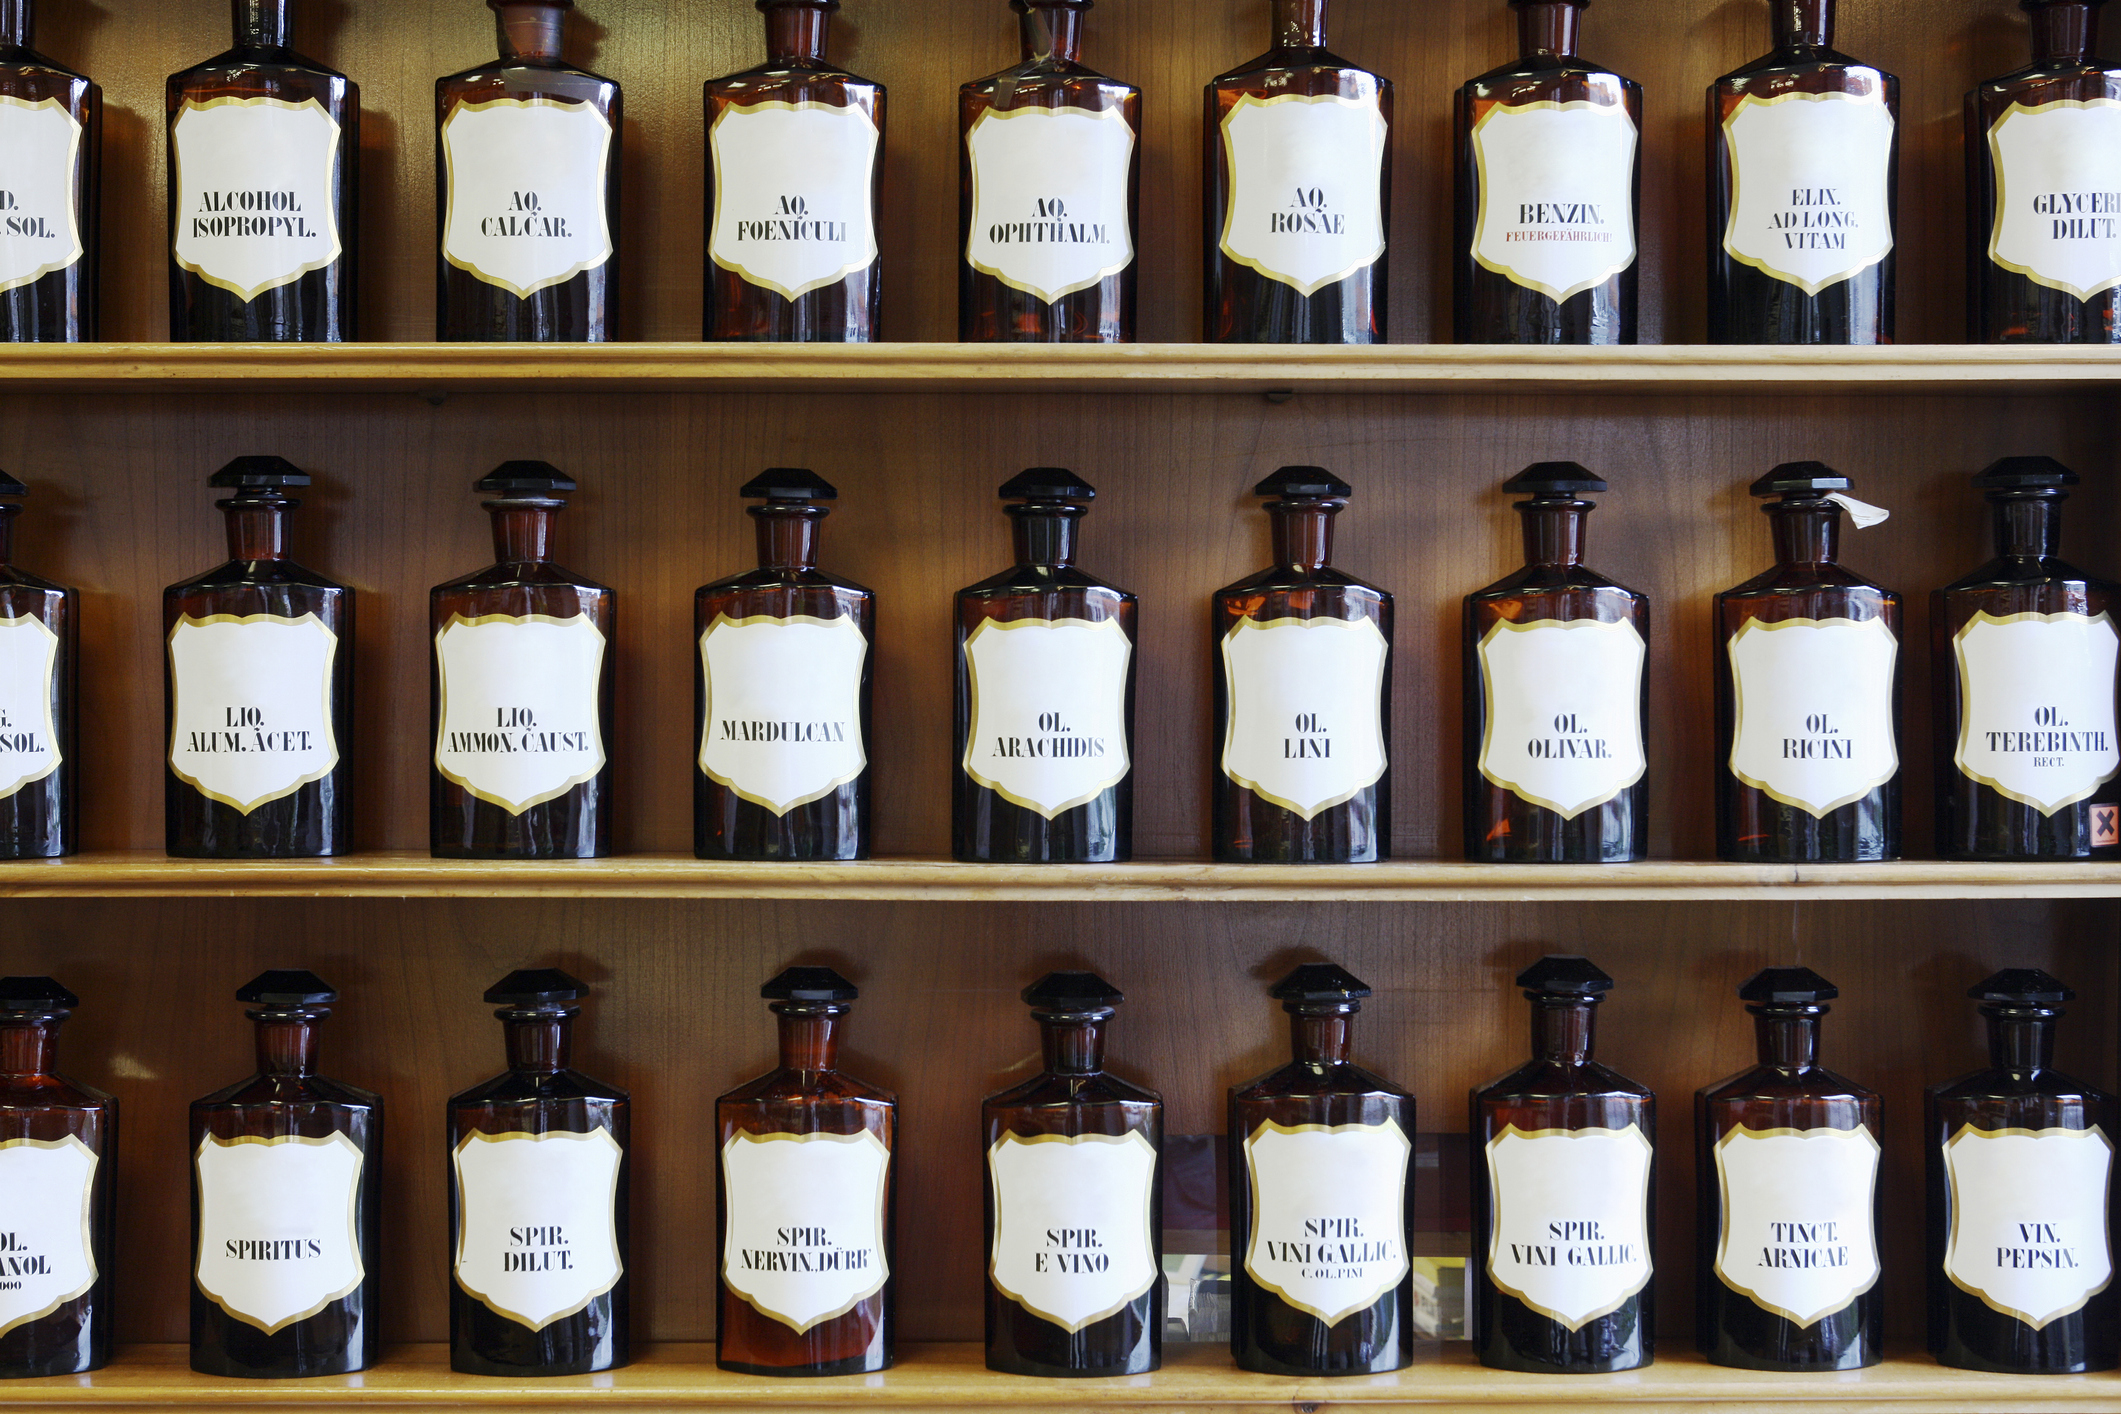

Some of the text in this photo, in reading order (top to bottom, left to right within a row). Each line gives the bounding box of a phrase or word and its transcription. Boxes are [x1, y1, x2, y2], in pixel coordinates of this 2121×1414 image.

[199, 190, 303, 212] ALCOHOL
[507, 190, 542, 217] AQ.
[774, 194, 809, 220] AQ.
[1288, 187, 1328, 213] AQ.
[1791, 188, 1841, 207] ELIX.
[1031, 197, 1068, 222] AQ.
[1519, 203, 1605, 225] BENZIN.
[1767, 210, 1859, 230] AD LONG.
[6, 215, 56, 239] SOL.
[192, 215, 317, 239] ISOPROPYL.
[481, 215, 572, 238] CALCAR.
[737, 220, 847, 242] FOENICULI
[989, 222, 1111, 245] OPHTHALM.
[1269, 212, 1345, 235] ROSAE
[2052, 218, 2117, 240] DILUT.
[1505, 228, 1613, 243] FEUERGEFÄHRLICH!
[1783, 232, 1847, 250] VITAM
[225, 706, 265, 731] LIQ.
[496, 707, 537, 732] LIQ.
[1039, 712, 1072, 733] OL.
[1295, 713, 1328, 734] OL.
[1554, 714, 1588, 735] OL.
[1806, 714, 1839, 734] OL.
[2034, 706, 2069, 727] OL.
[186, 730, 313, 753] ALUM. ACET.
[447, 731, 589, 753] AMMON. CAUST.
[719, 720, 846, 743] MARDULCAN
[1985, 731, 2109, 752] TEREBINTH.
[0, 732, 45, 754] SOL.
[992, 736, 1105, 759] ARACHIDIS
[1284, 738, 1332, 759] LINI
[1528, 738, 1613, 759] OLIVAR.
[1781, 738, 1853, 760] RICINI
[2033, 756, 2064, 768] RECT.
[509, 1226, 569, 1248] SPIR.
[777, 1226, 833, 1248] SPIR.
[1304, 1217, 1364, 1238] SPIR.
[1549, 1221, 1605, 1241] SPIR.
[1770, 1222, 1839, 1244] TINCT.
[2018, 1223, 2061, 1244] VIN.
[225, 1239, 322, 1261] SPIRITUS
[1046, 1228, 1104, 1250] SPIR.
[503, 1250, 574, 1272] DILUT.
[1035, 1252, 1109, 1274] E VINO
[1267, 1240, 1397, 1264] VINI GALLIC.
[1510, 1243, 1637, 1267] VINI GALLIC.
[1757, 1245, 1849, 1269] ARNICAE
[1996, 1246, 2079, 1269] PEPSIN.
